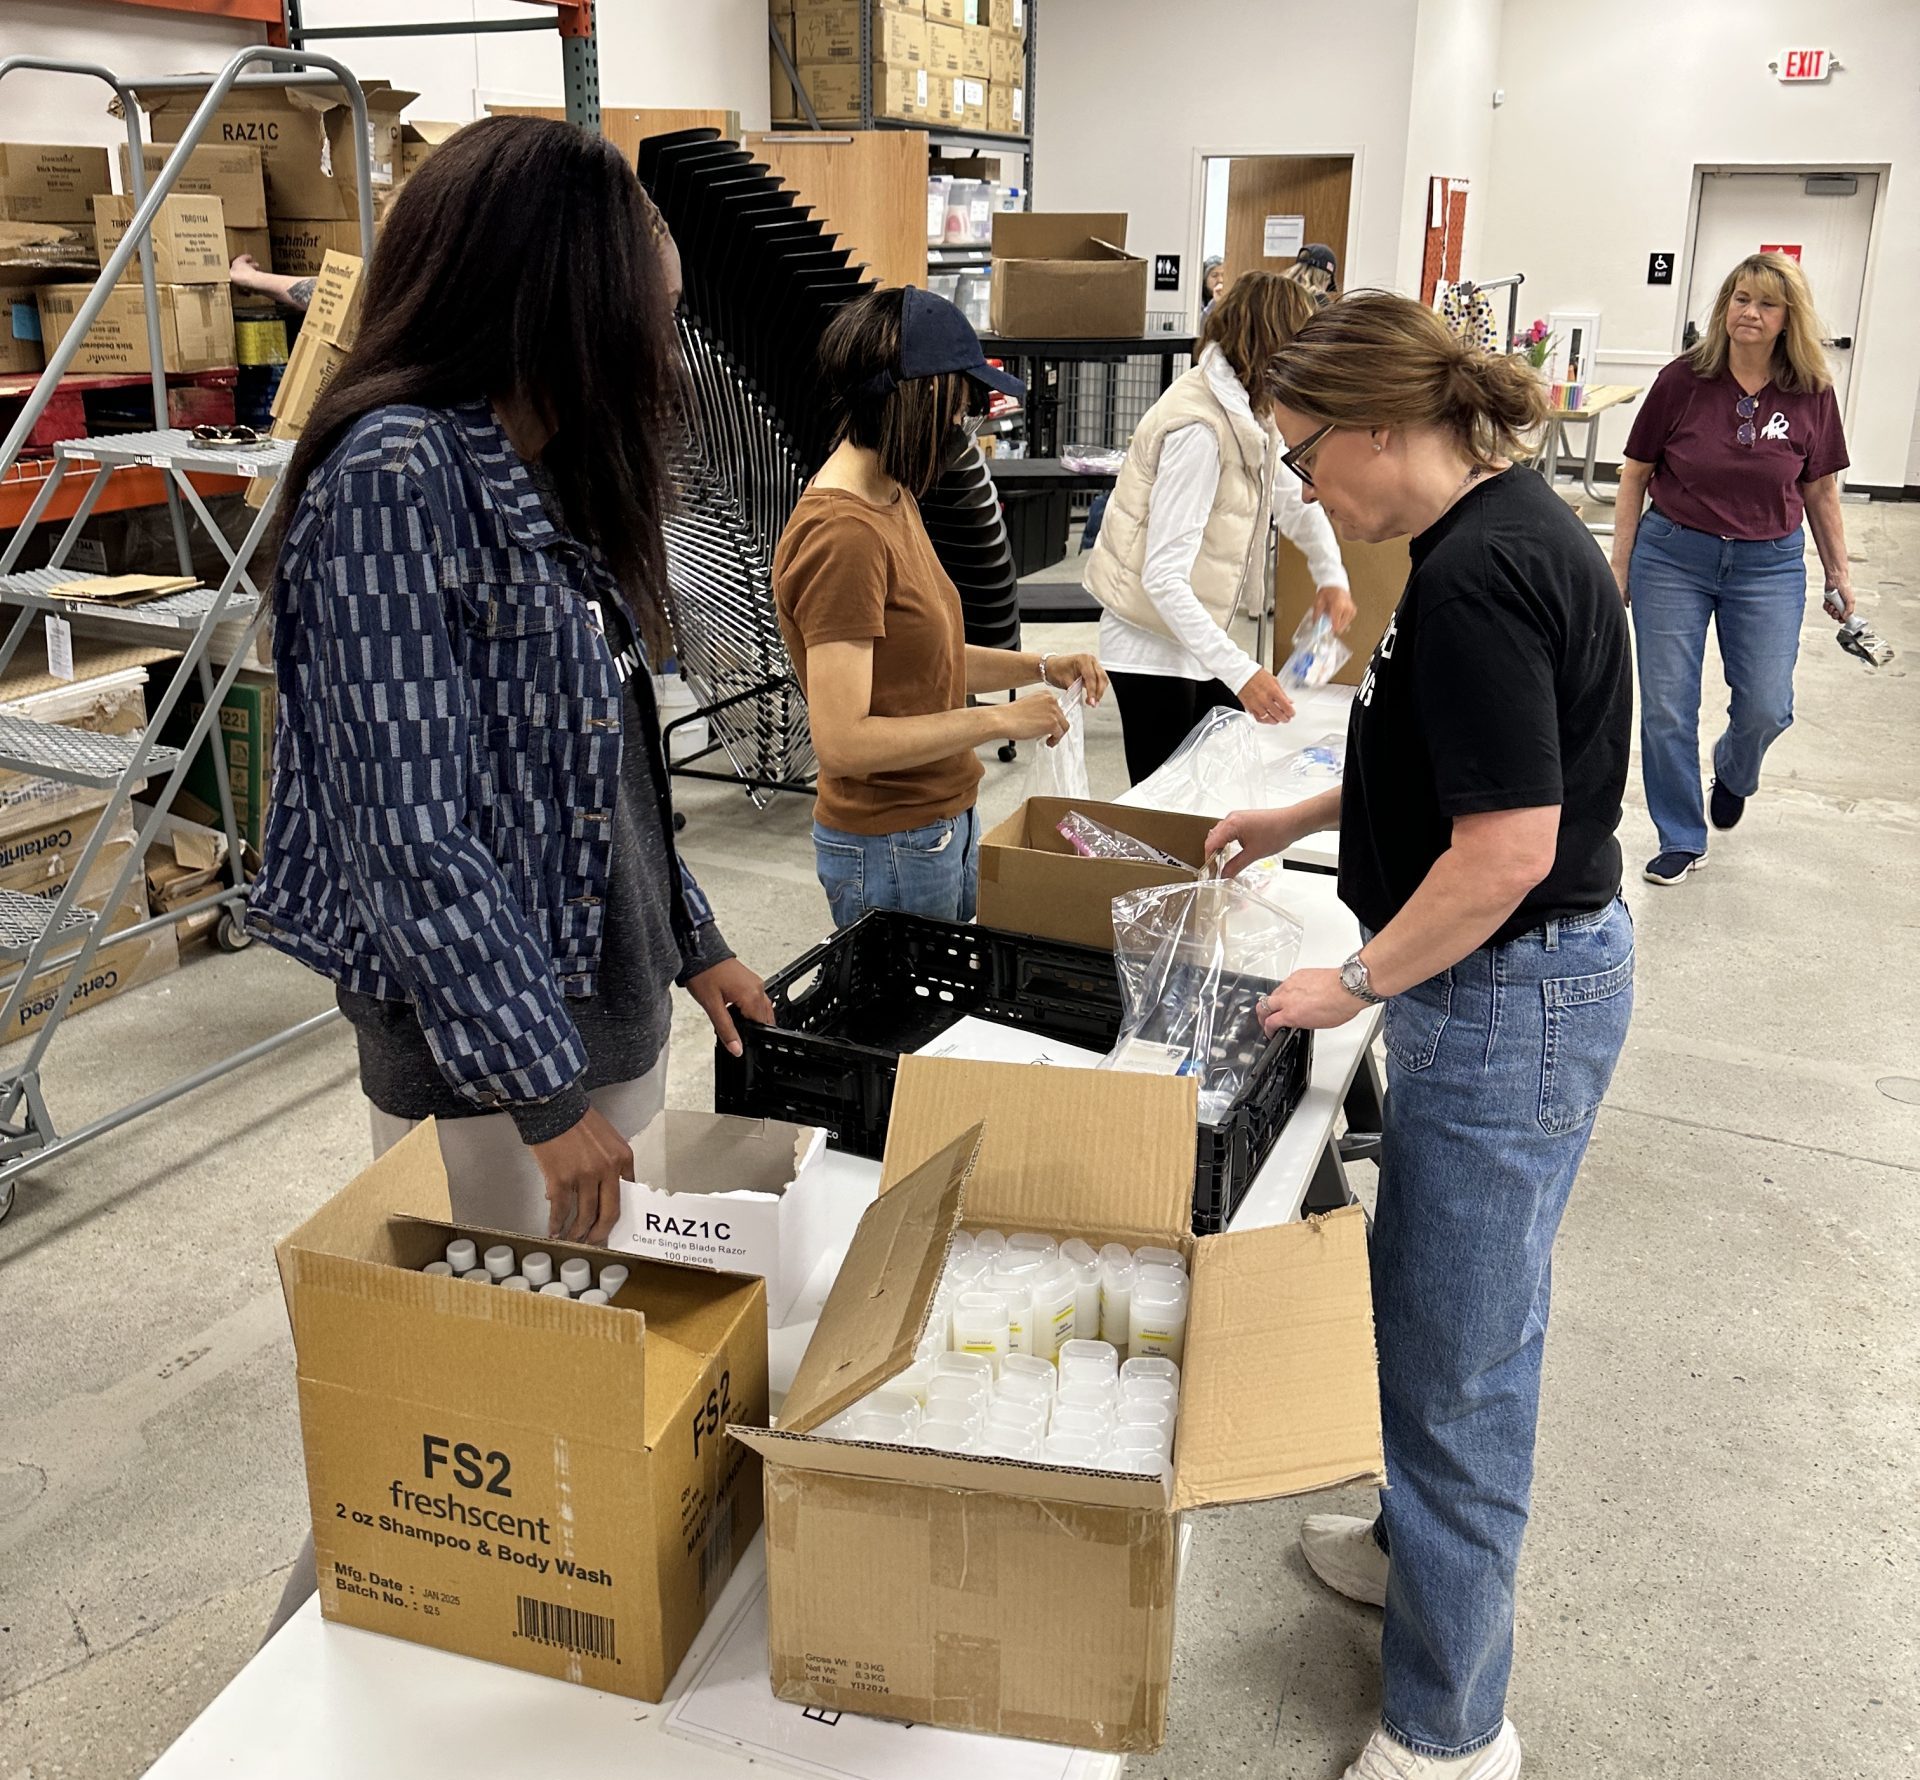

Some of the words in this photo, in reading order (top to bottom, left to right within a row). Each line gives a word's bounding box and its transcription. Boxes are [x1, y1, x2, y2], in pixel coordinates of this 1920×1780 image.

[1786, 51, 1824, 77] EXIT
[223, 123, 279, 141] RAZ1C
[646, 1213, 731, 1240] RAZ1C
[632, 1233, 656, 1246] Clear
[658, 1239, 687, 1250] Single
[689, 1242, 716, 1253] Blade
[718, 1246, 746, 1256] Razor
[664, 1252, 681, 1262] 100
[683, 1254, 713, 1265] pieces
[693, 1370, 731, 1460] FS2
[423, 1434, 512, 1497] FS2
[389, 1480, 551, 1544] freshscent
[336, 1503, 347, 1518] 2
[352, 1510, 374, 1528] oz
[379, 1516, 470, 1552] Shampoo
[477, 1539, 492, 1557] &
[498, 1544, 550, 1574] Body
[555, 1558, 613, 1586] Wash
[335, 1561, 367, 1582] Mfg.
[369, 1572, 403, 1591] Date
[422, 1588, 439, 1601] JAN
[440, 1593, 460, 1606] 2025
[336, 1577, 379, 1600] Batch
[383, 1591, 408, 1608] No.
[423, 1604, 440, 1616] 525
[805, 1653, 832, 1664] Gross
[805, 1663, 821, 1672] Net
[805, 1673, 819, 1681] Lot
